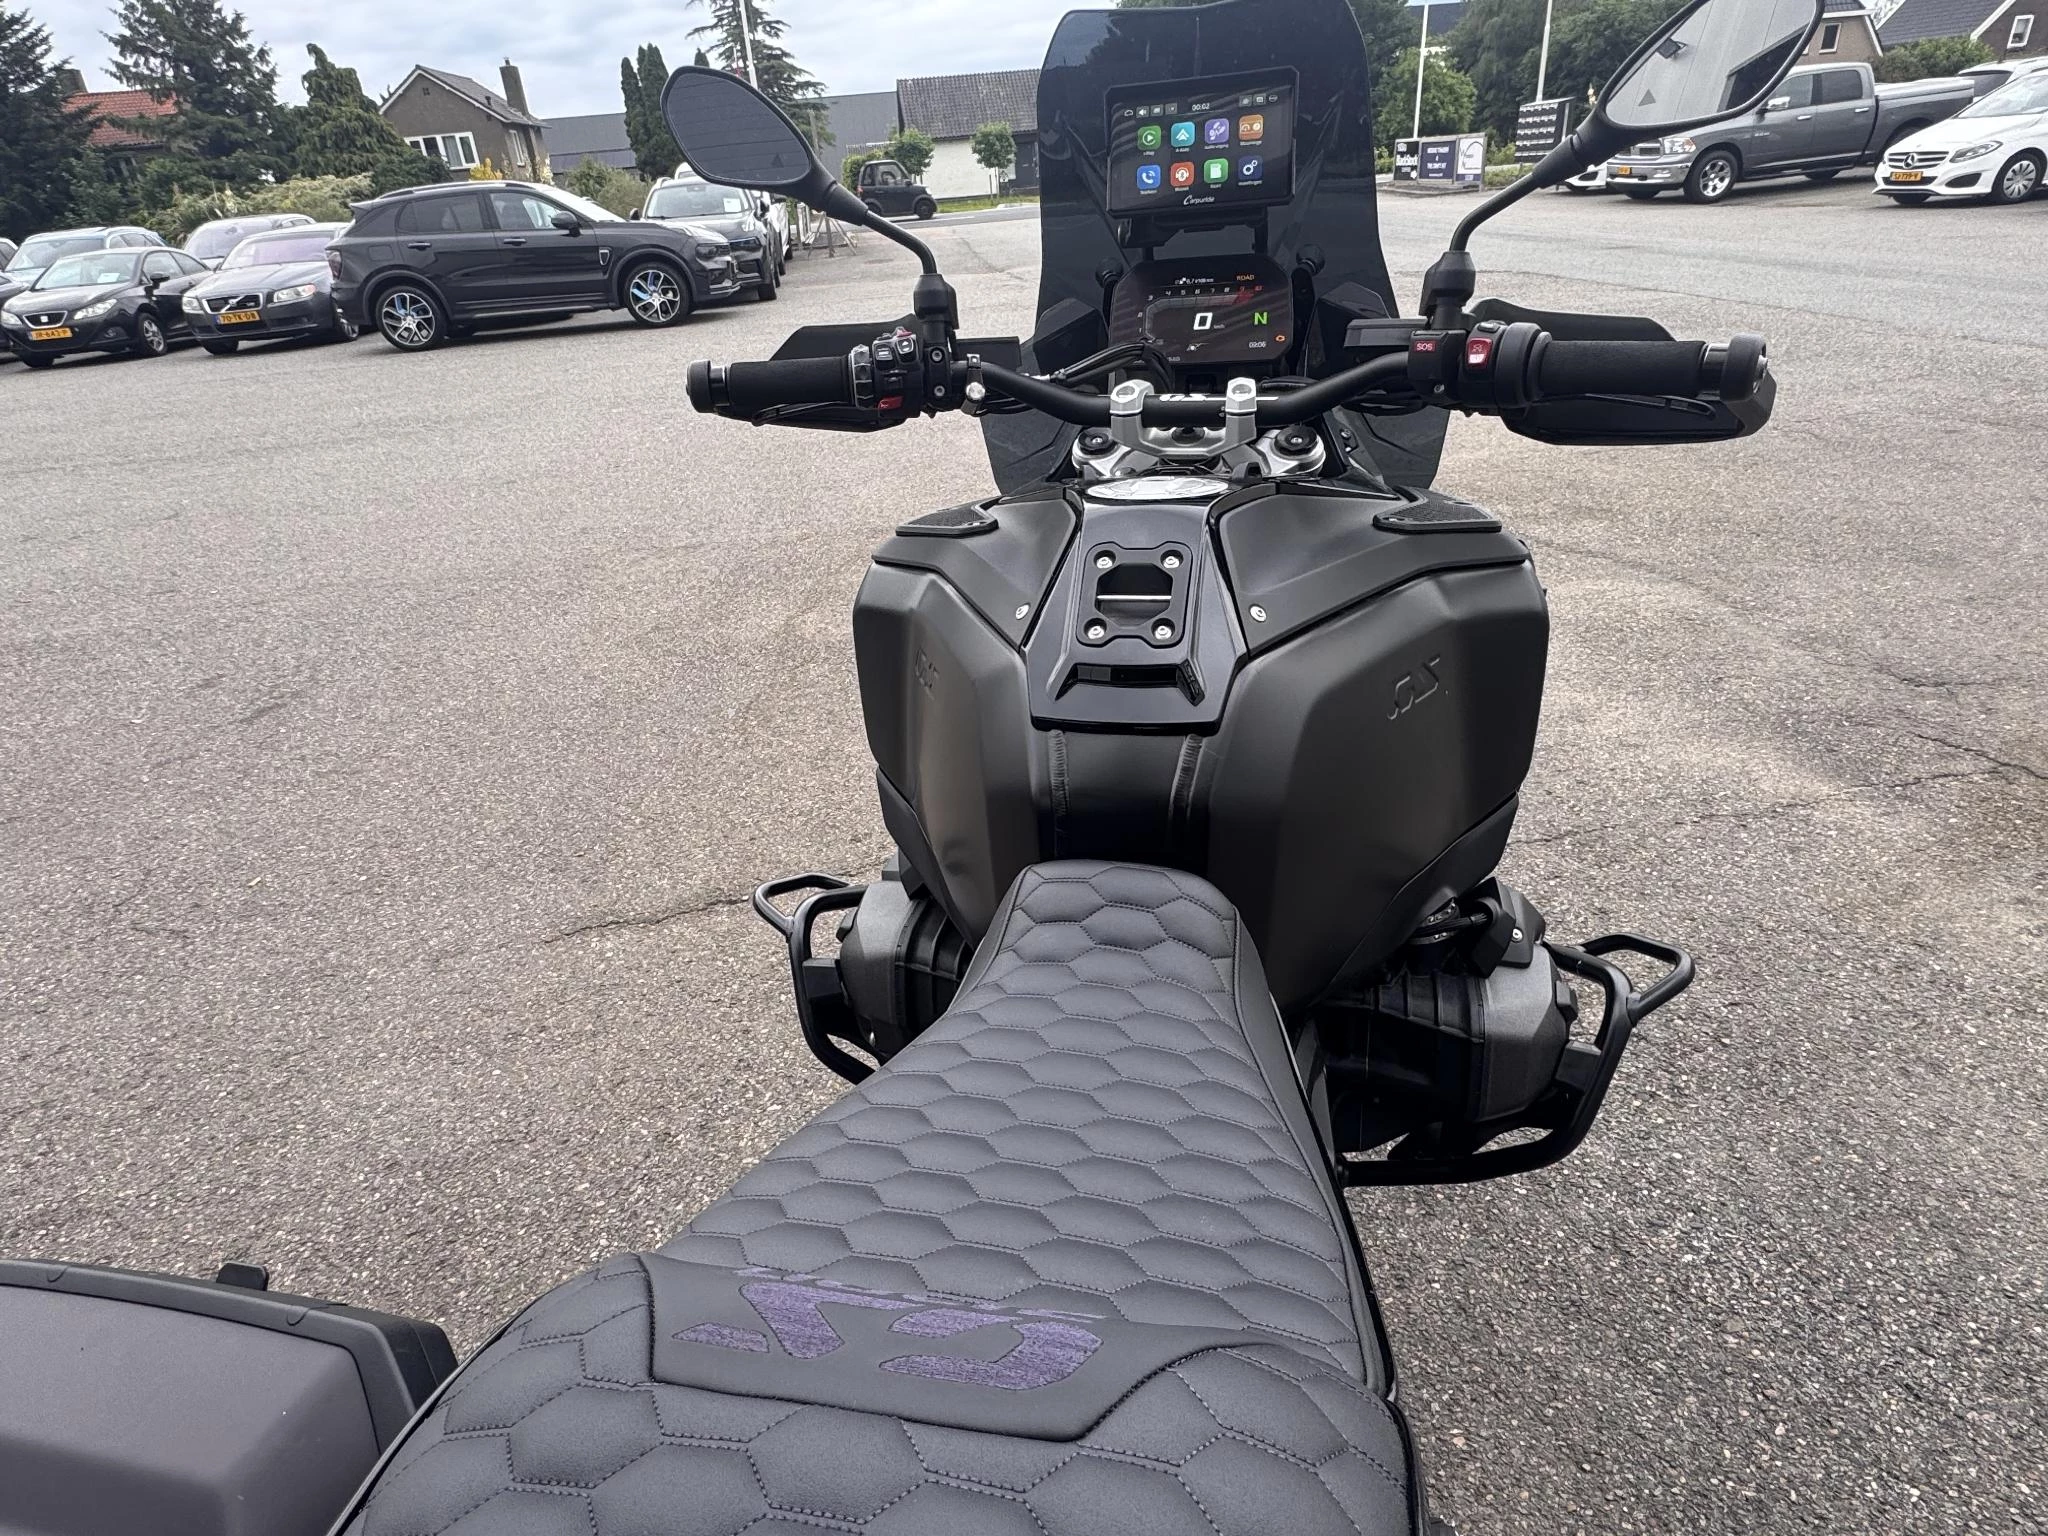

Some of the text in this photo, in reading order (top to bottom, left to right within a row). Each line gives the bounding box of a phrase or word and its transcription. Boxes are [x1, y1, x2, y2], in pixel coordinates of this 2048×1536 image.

[1193, 312, 1213, 330] 0
[1253, 311, 1268, 325] N
[1416, 342, 1433, 351] SOS
